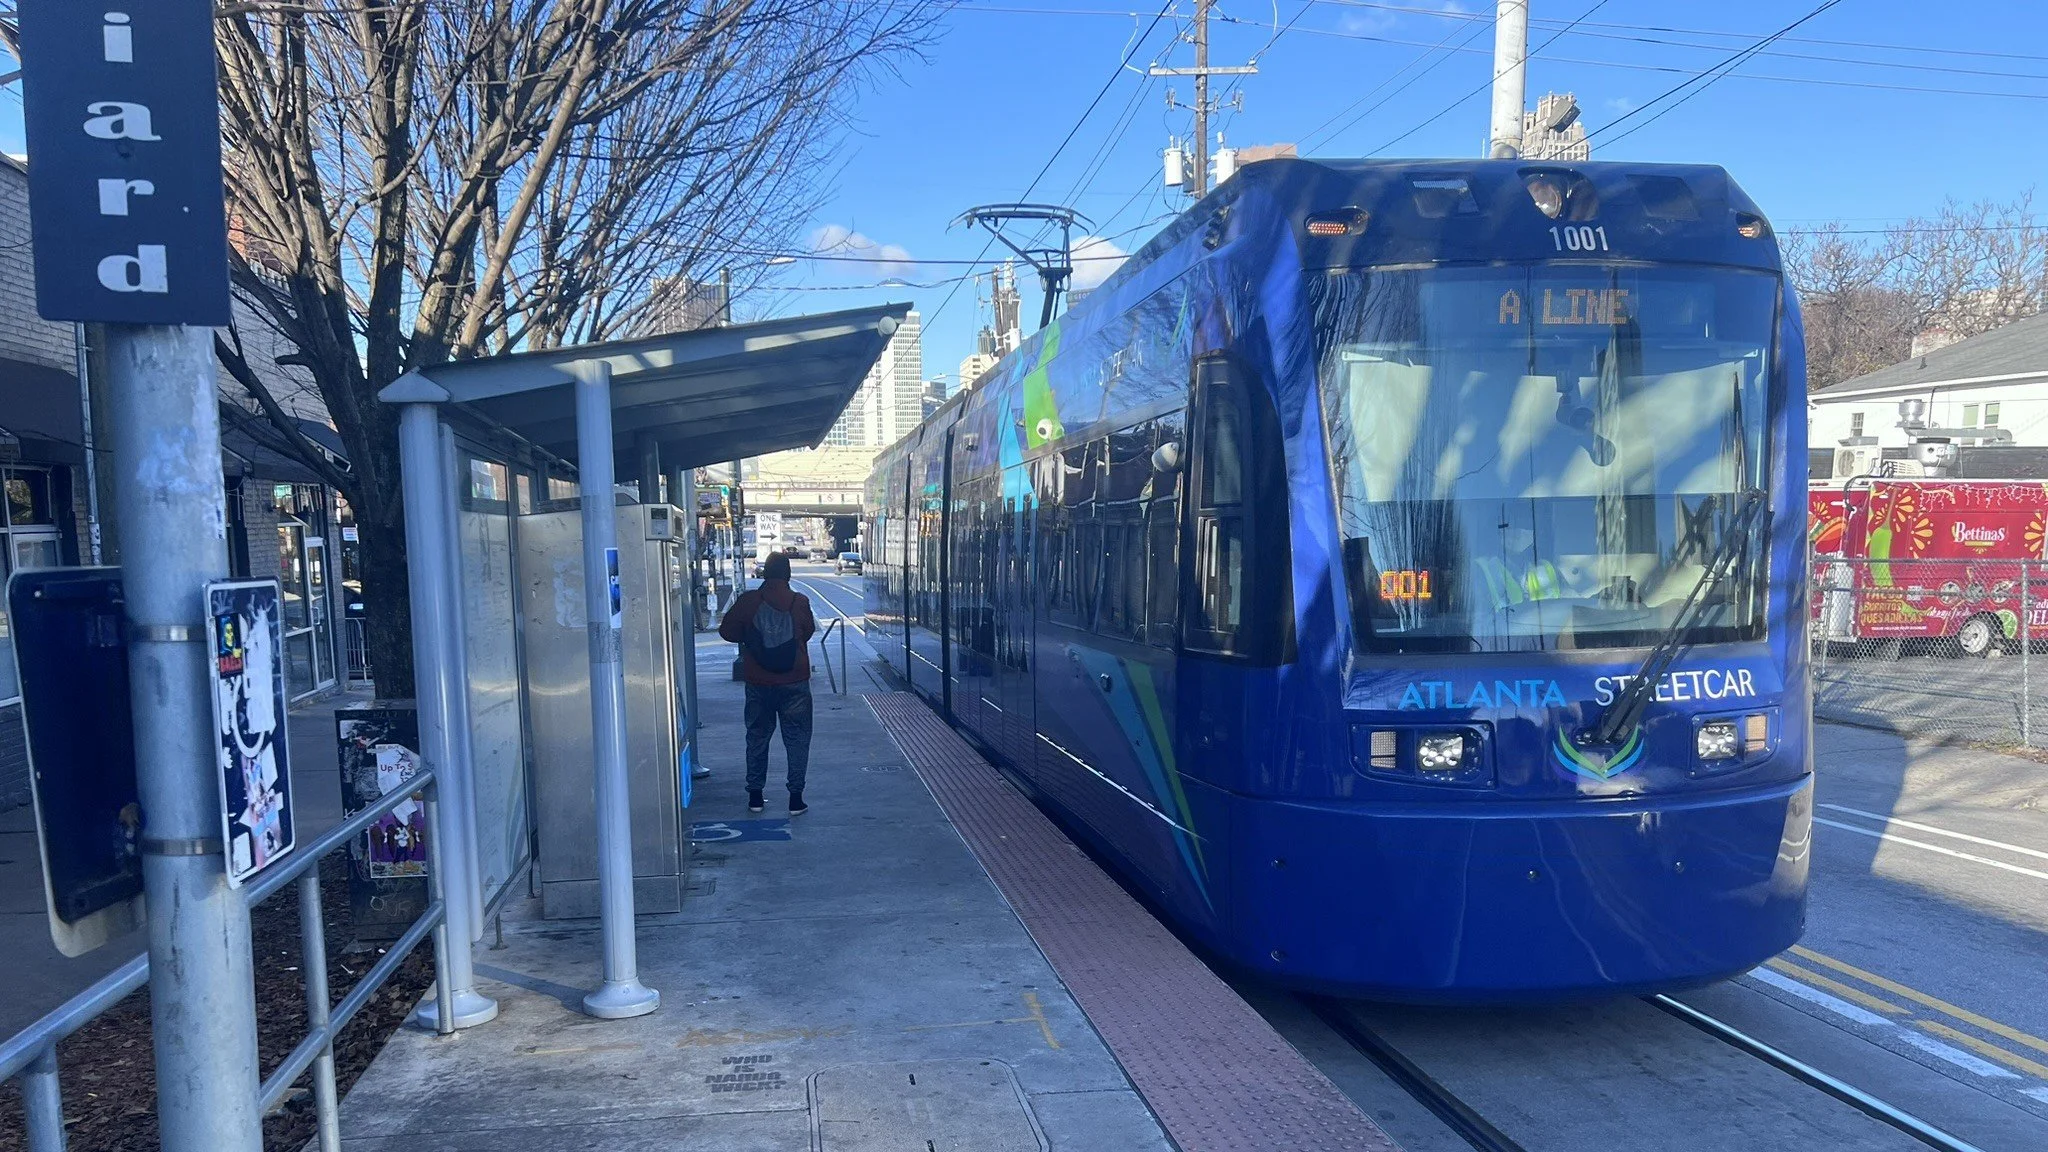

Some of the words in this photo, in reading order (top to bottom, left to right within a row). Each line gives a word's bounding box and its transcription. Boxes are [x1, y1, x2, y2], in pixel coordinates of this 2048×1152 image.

[1549, 226, 1609, 251] 1001
[1499, 288, 1521, 324] A
[1542, 288, 1629, 325] LINE
[760, 514, 776, 522] ONE
[1381, 570, 1433, 599] 001
[1399, 679, 1567, 711] ATLANTA
[721, 1055, 773, 1065] WHO
[733, 1065, 756, 1073] IS
